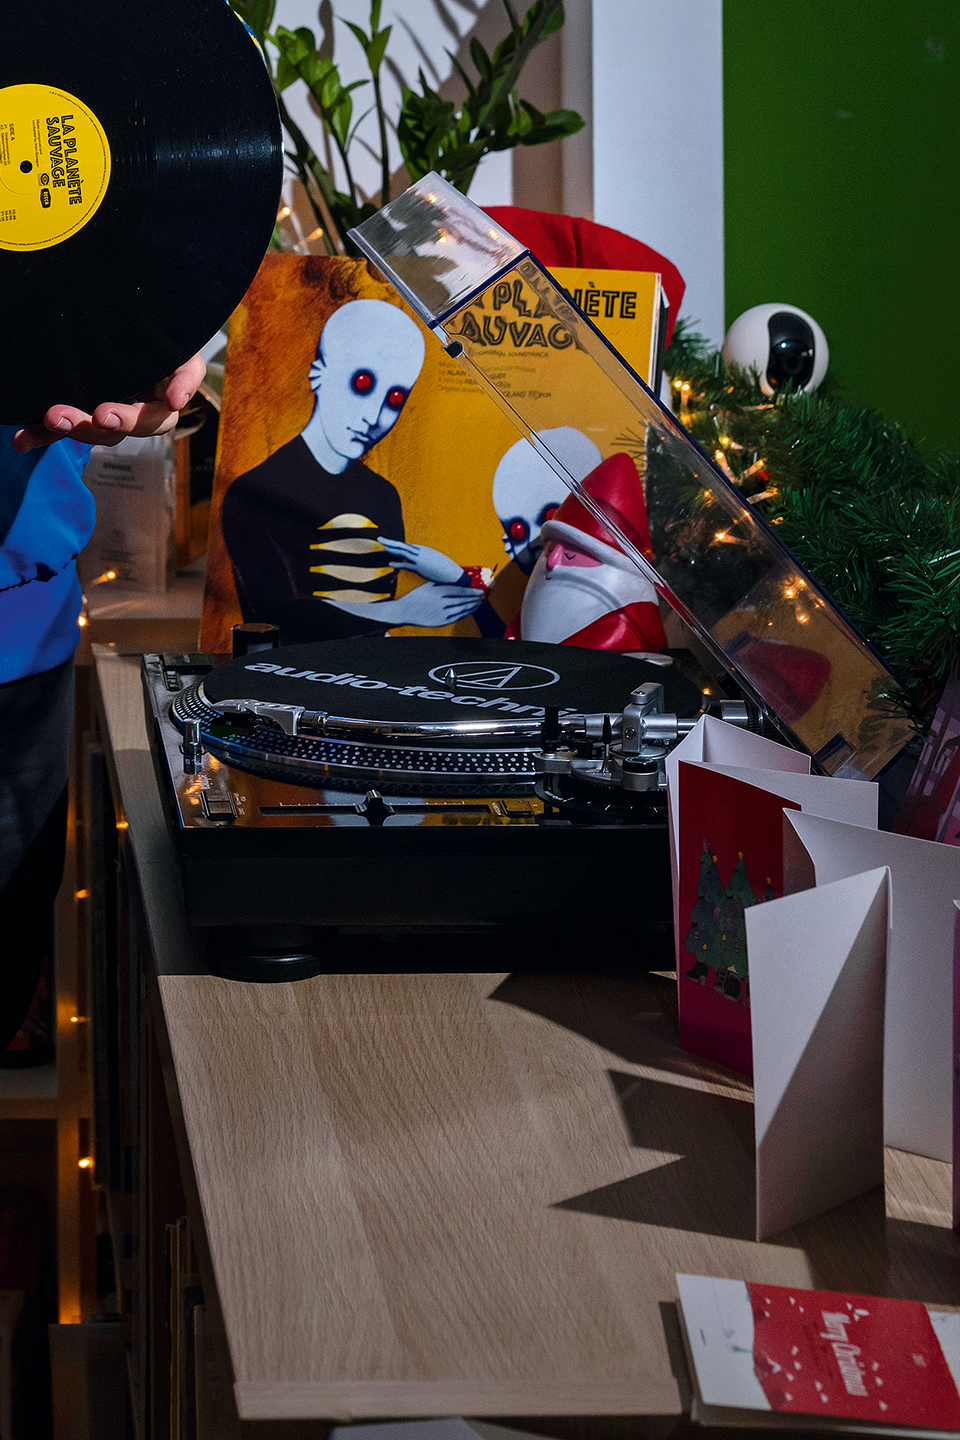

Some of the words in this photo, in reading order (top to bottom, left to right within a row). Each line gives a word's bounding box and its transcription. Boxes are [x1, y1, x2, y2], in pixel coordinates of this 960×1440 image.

[46, 116, 66, 188] SAUVAGE
[61, 114, 75, 136] LA
[63, 137, 84, 205] PLANÈTE
[244, 662, 582, 718] audio-techni
